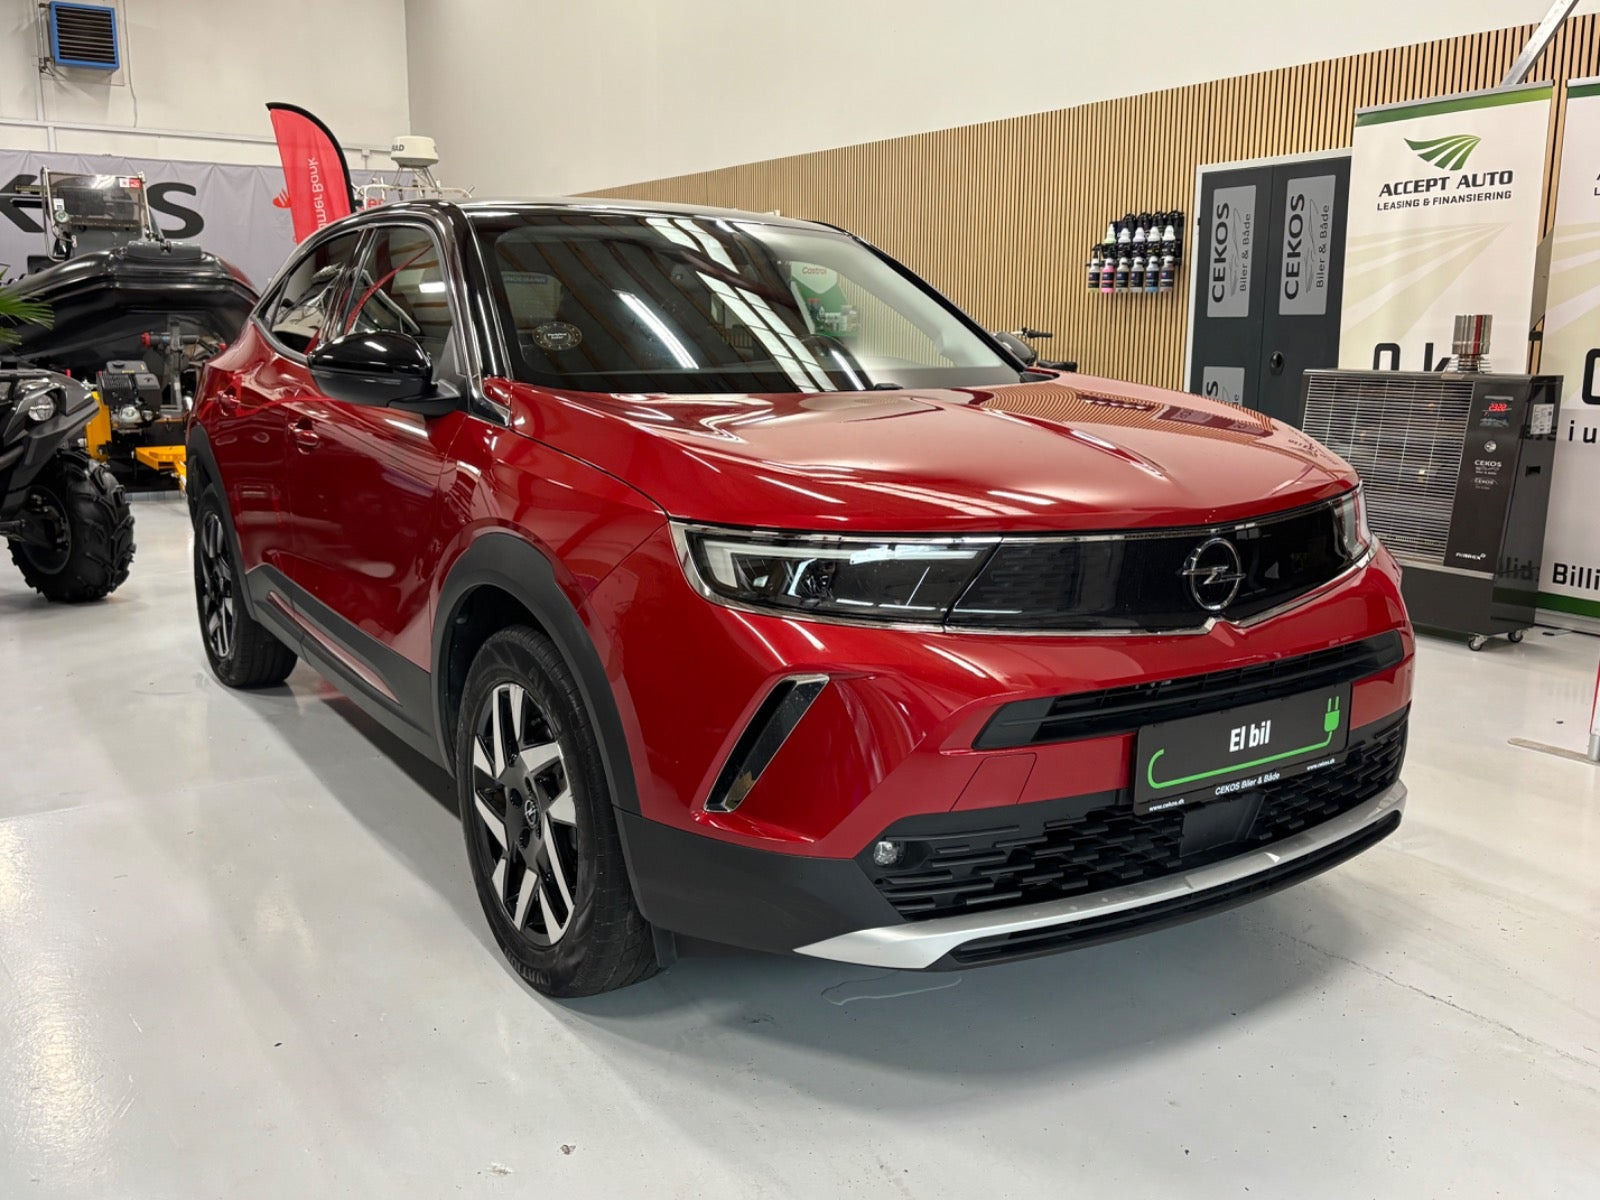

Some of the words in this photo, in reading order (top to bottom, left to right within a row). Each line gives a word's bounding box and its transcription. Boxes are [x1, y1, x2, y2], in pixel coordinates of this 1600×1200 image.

[1378, 176, 1451, 198] ACCEPT
[1456, 170, 1513, 189] AUTO
[1376, 199, 1420, 211] LEASING
[1423, 198, 1431, 206] &
[1432, 190, 1512, 205] FINANSIERING
[1319, 204, 1330, 239] Både
[1211, 202, 1230, 303] CEKOS
[1241, 250, 1248, 259] &
[1284, 193, 1305, 300] CEKOS
[1318, 244, 1326, 254] &
[802, 266, 827, 276] Castrol
[1315, 259, 1325, 288] Biler
[1228, 725, 1247, 753] El
[1248, 720, 1272, 748] bil
[1214, 782, 1240, 795] CEKOS
